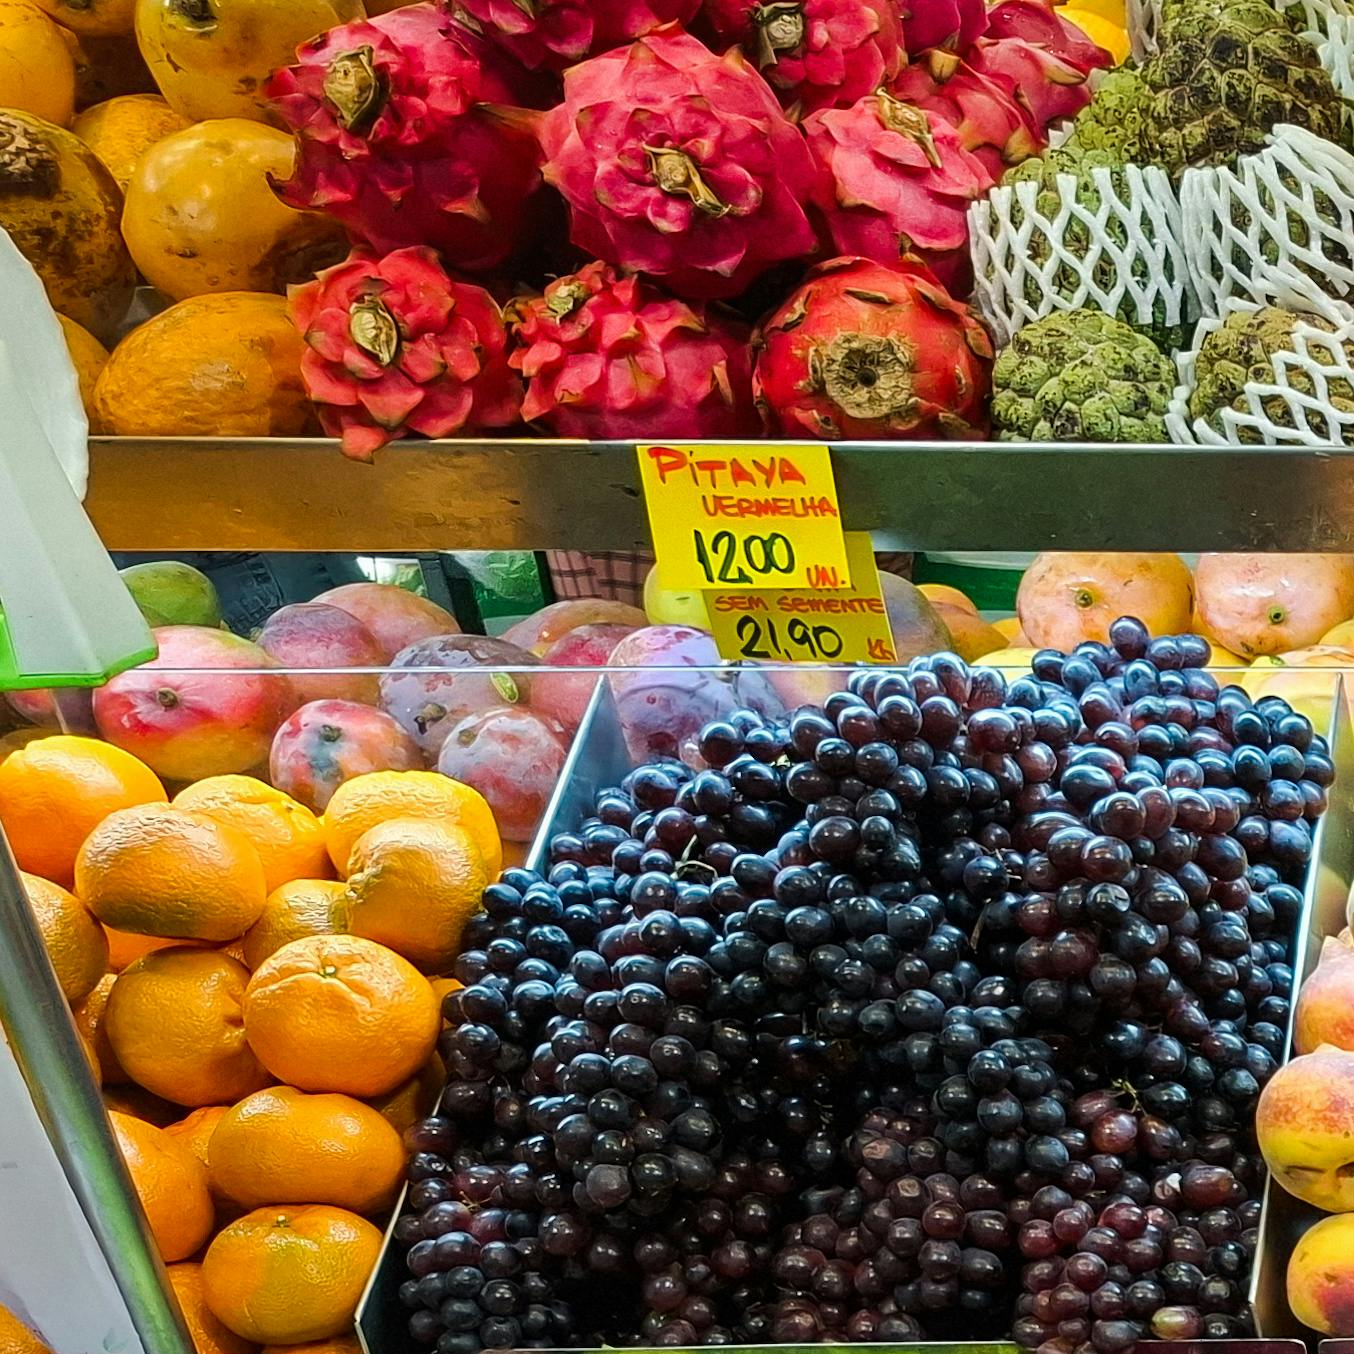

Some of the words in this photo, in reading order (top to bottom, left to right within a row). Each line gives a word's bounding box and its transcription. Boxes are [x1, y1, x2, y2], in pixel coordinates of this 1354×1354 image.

[702, 495, 838, 518] VERMELHA
[715, 595, 769, 612] SEM
[776, 595, 886, 614] SEMENTE
[736, 614, 844, 661] 21,90
